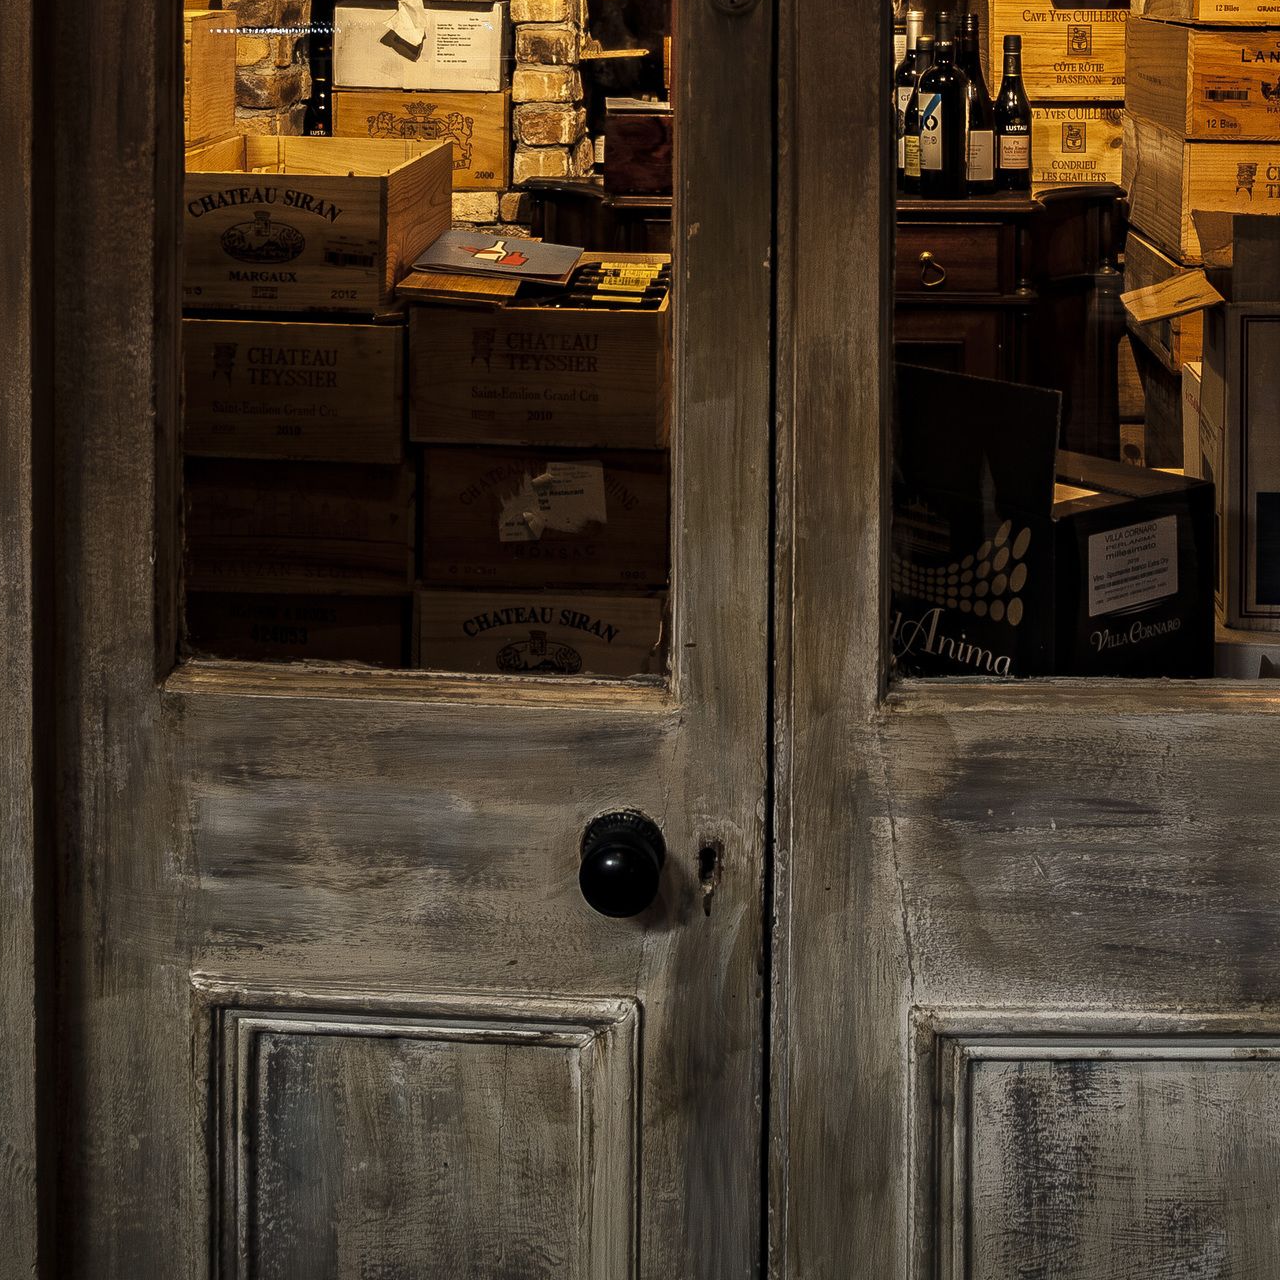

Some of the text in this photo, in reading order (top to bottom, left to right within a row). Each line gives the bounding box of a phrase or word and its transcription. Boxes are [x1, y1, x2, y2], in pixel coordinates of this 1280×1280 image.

[1053, 61, 1104, 72] CÔTE RÔTIE
[1056, 75, 1101, 84] BASSENON
[1206, 119, 1216, 128] 12
[1052, 160, 1097, 169] CONDRIEU
[475, 171, 494, 179] 2000
[1042, 172, 1057, 181] LES
[188, 188, 343, 224] CHATEAU SIRAN
[229, 271, 297, 283] MARGAUX
[331, 290, 357, 299] 2012
[506, 332, 599, 351] CHATEAU
[248, 347, 338, 367] CHATEAU
[506, 353, 598, 372] TEYSSIER
[248, 368, 338, 388] TEYSSIER
[471, 386, 599, 402] Saint-Emilion Grand Cru
[284, 403, 316, 416] Grand
[319, 405, 338, 417] Cru
[527, 411, 553, 421] 2010
[1105, 523, 1157, 543] VILLA CORNARO
[1105, 542, 1156, 560] millesimato
[462, 607, 619, 643] CHATEAU SIRAN
[1090, 617, 1182, 652] VILLA CORNARO
